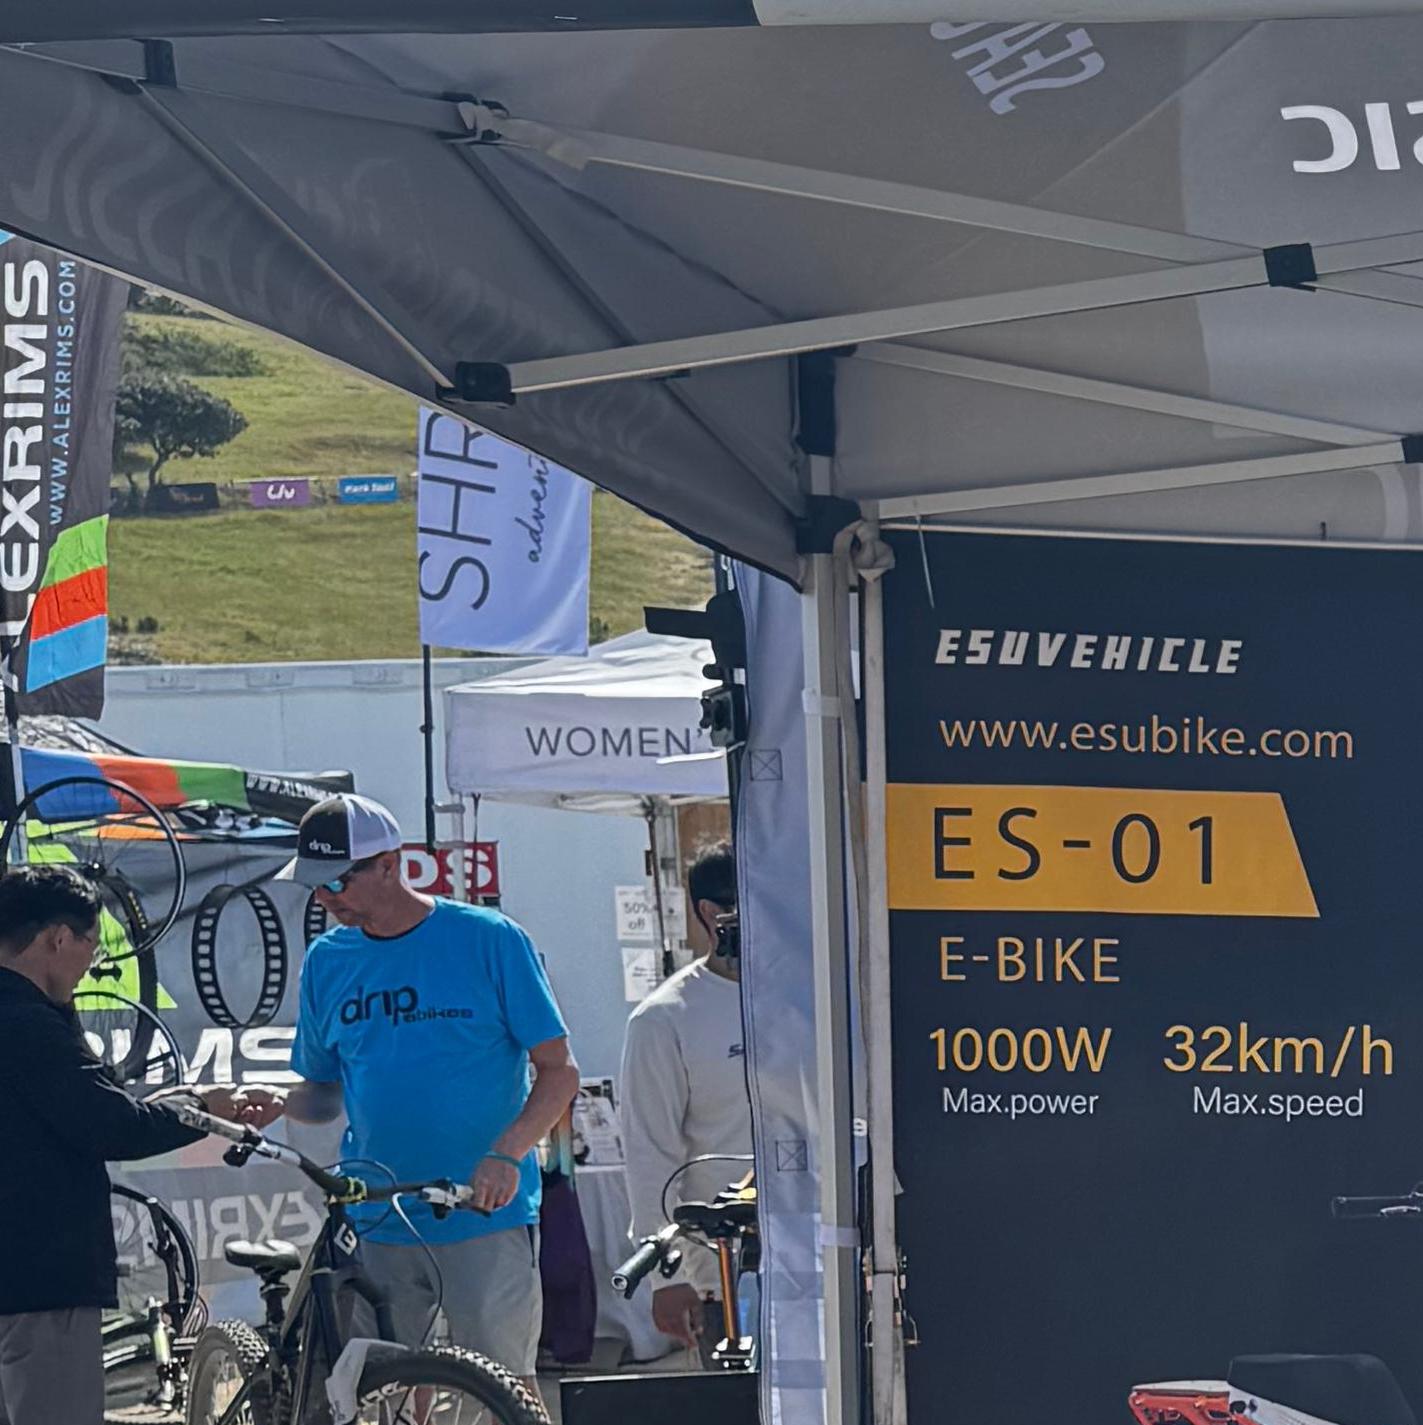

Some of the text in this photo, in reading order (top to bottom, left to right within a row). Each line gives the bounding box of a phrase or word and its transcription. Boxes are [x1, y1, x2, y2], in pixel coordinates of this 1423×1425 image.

[49, 260, 76, 526] WWW.ALEXRIMS.COM
[935, 629, 1244, 675] ESUVEHICLE
[938, 714, 1357, 760] www.esubike.com
[933, 806, 1216, 885] ES-01
[940, 935, 1120, 984] E-BIKE
[928, 1026, 1112, 1074] 1000W
[1162, 1021, 1396, 1078] 32km/h
[942, 1087, 1100, 1121] Max.power
[1192, 1085, 1365, 1122] Max.speed
